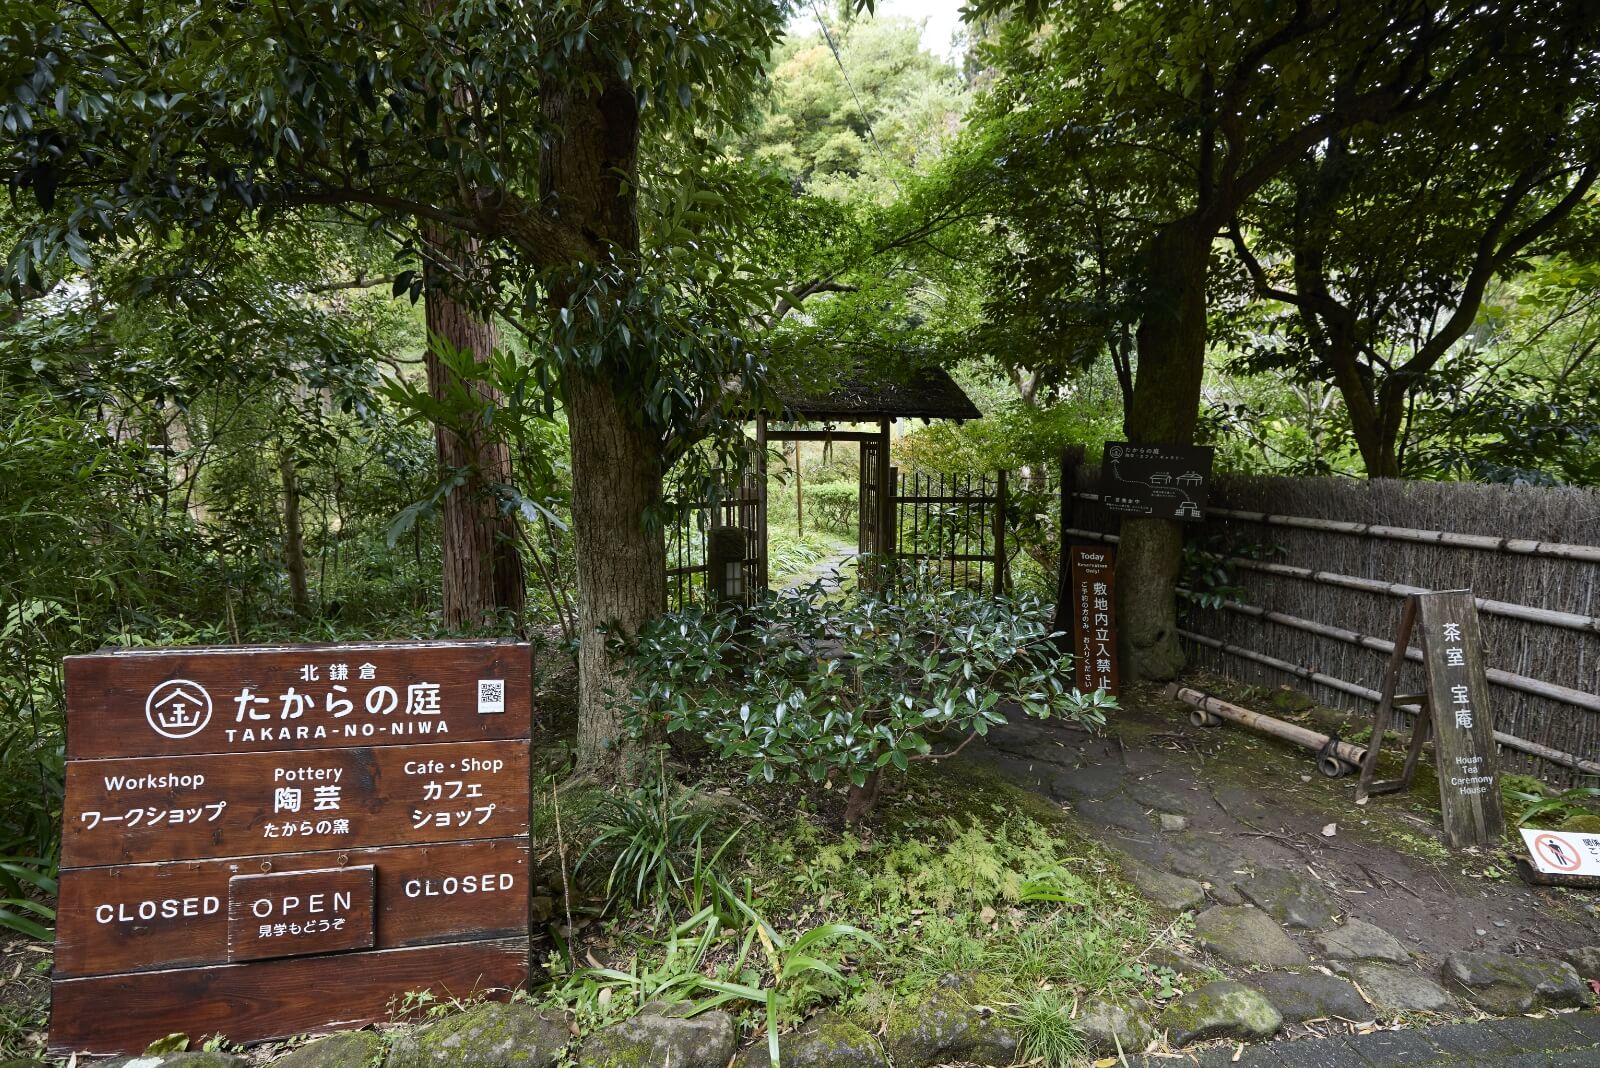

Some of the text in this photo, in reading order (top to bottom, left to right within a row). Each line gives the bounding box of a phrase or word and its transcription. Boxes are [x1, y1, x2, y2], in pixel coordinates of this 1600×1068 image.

[1080, 552, 1105, 562] Today
[1093, 582, 1112, 690] 敷地内立入禁止
[300, 662, 377, 681] 北鎌倉
[1442, 622, 1473, 729] 茶室 宝庵
[234, 682, 441, 722] たからの庭
[225, 720, 449, 742] TAKARA-NO-NIWA
[1455, 756, 1483, 765] Houan
[1462, 765, 1479, 774] Tea
[104, 773, 205, 791] Workshop
[274, 767, 343, 787] Pottery
[1451, 774, 1494, 786] Ceremony
[274, 785, 342, 813] 陶芸
[423, 781, 483, 800] カフェ
[1459, 786, 1487, 796] House
[80, 801, 227, 830] ワークショップ
[412, 803, 496, 829] ショップ
[263, 818, 350, 838] たからの窯
[405, 873, 515, 898] CLOSED
[95, 896, 220, 924] CLOSED
[253, 891, 351, 918] OPEN
[259, 918, 346, 938] 見学もどうぞ
